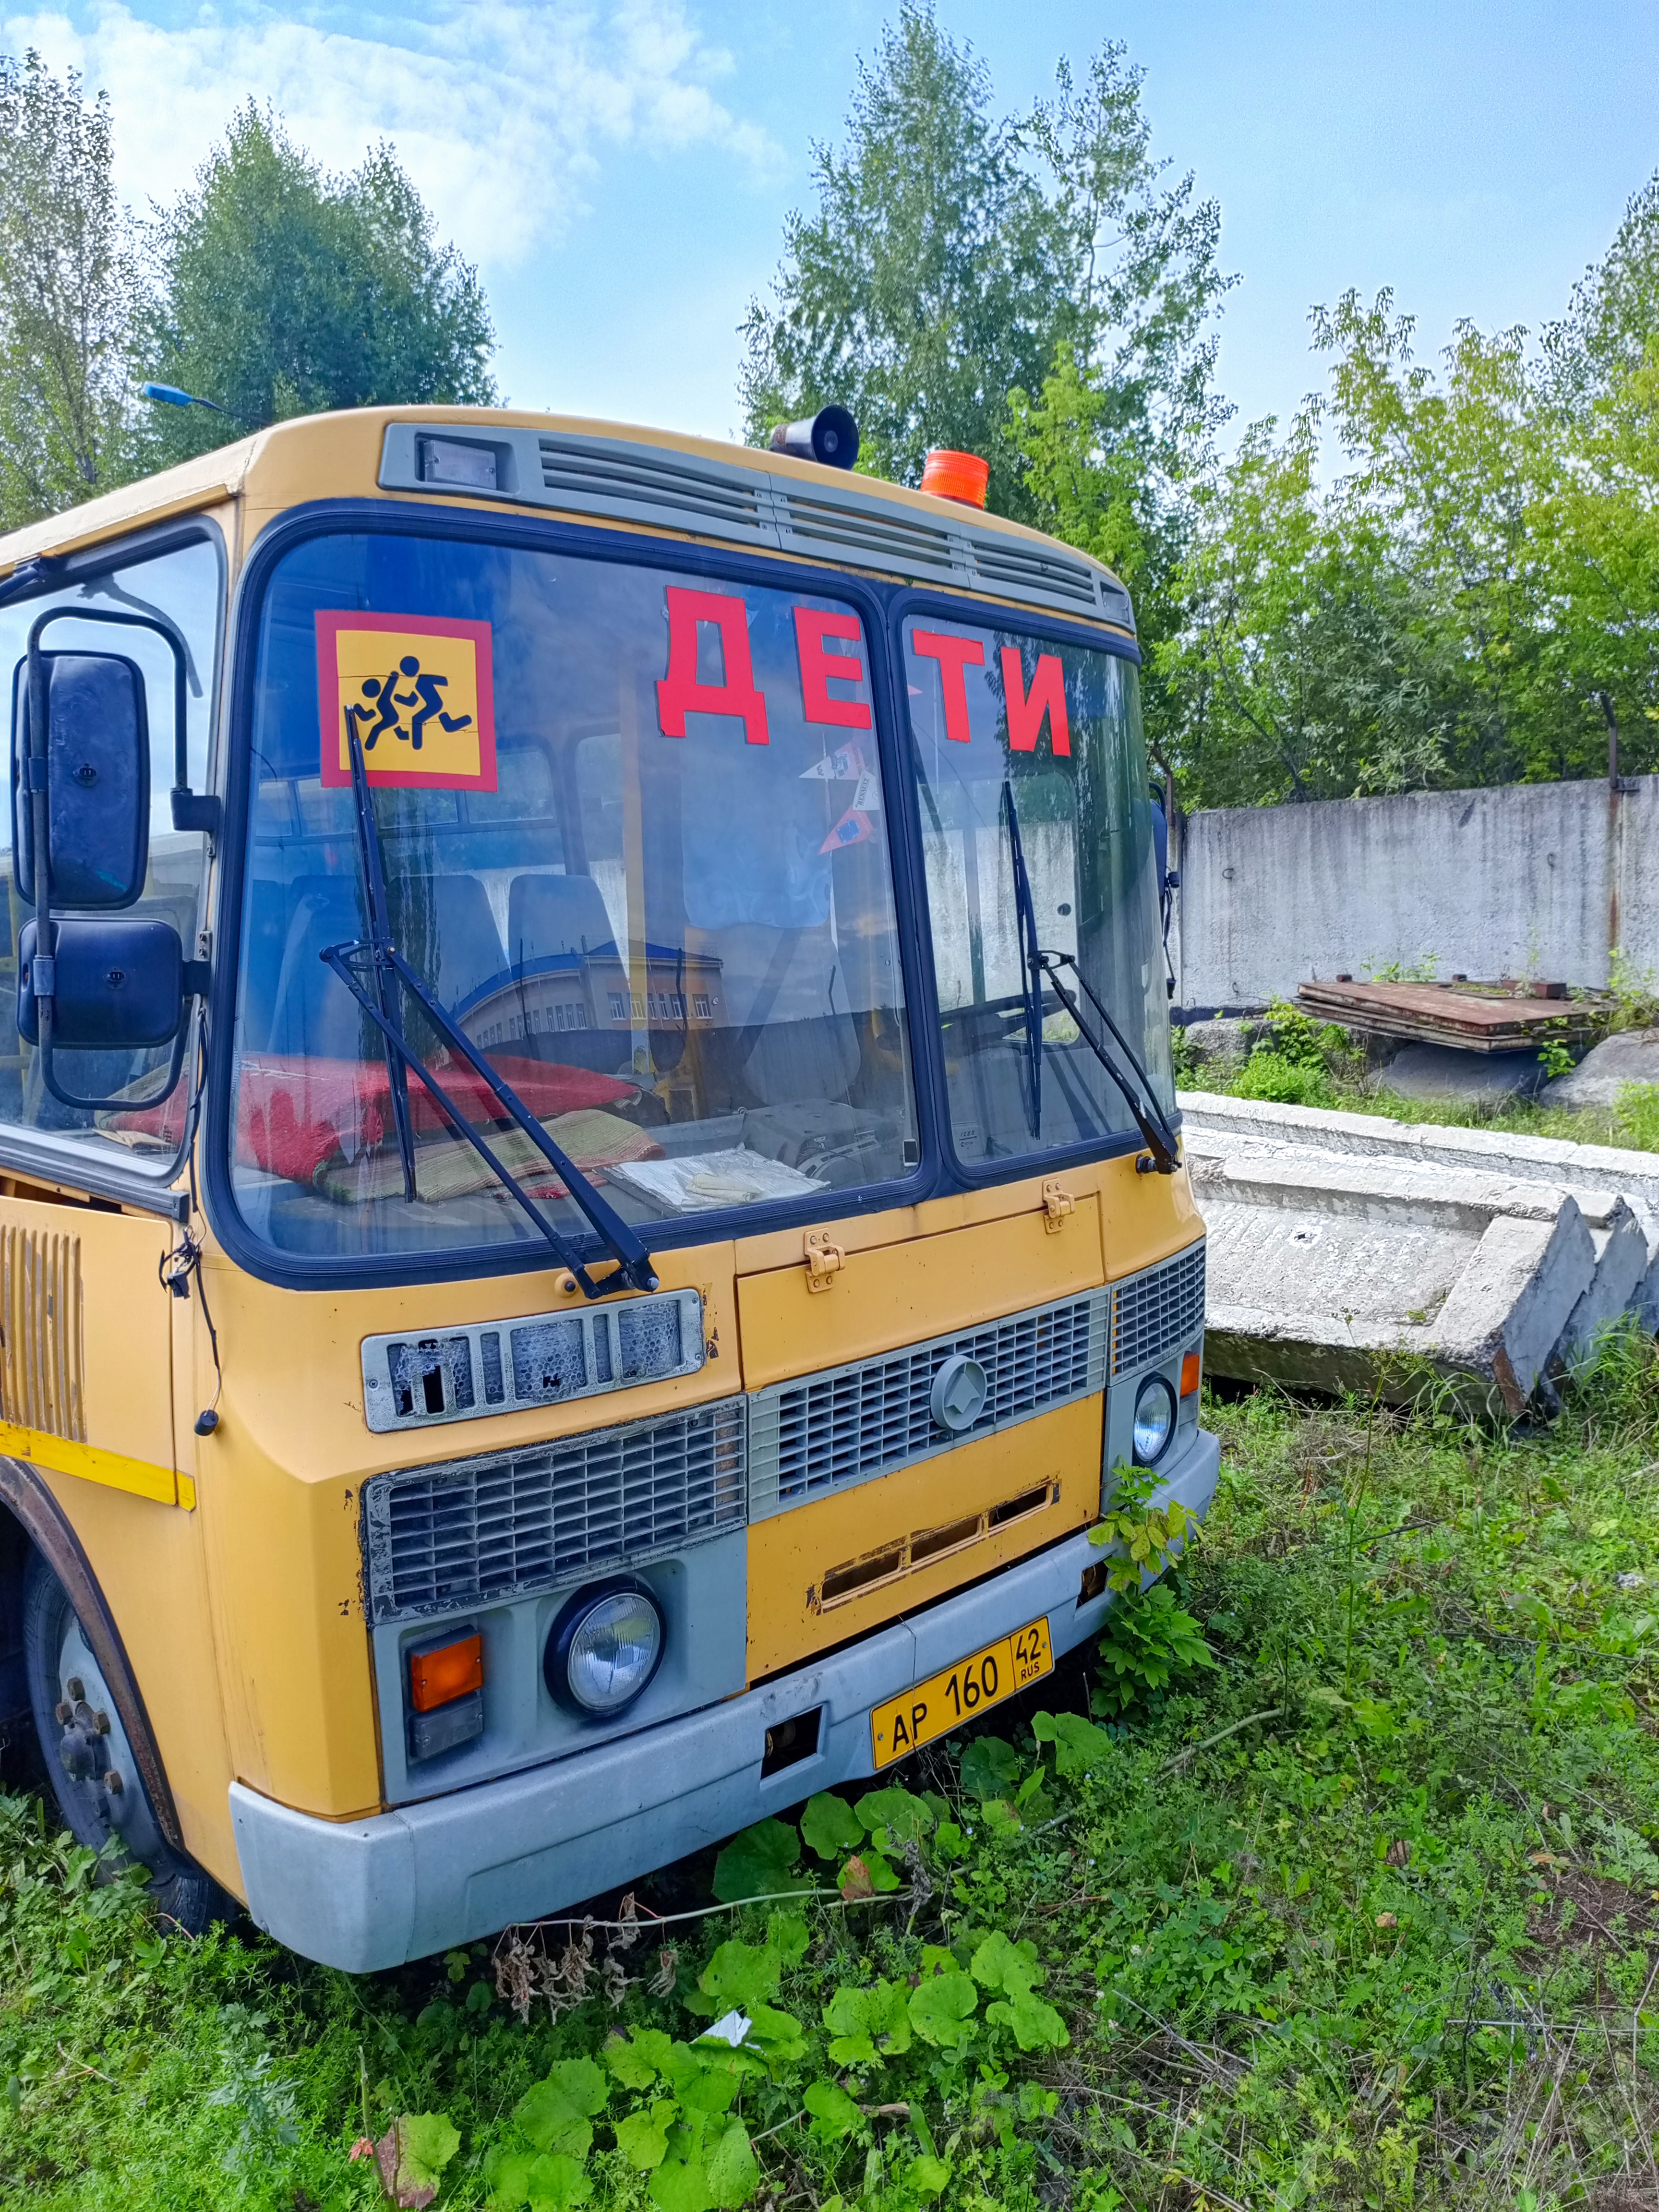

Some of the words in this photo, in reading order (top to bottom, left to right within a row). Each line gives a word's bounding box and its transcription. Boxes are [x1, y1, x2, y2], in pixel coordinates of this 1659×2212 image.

[655, 585, 1070, 757] ДЕТИ
[857, 777, 870, 806] RENAULT
[1015, 1628, 1041, 1664] 42
[944, 1655, 998, 1717] 160
[1020, 1660, 1040, 1681] RUS
